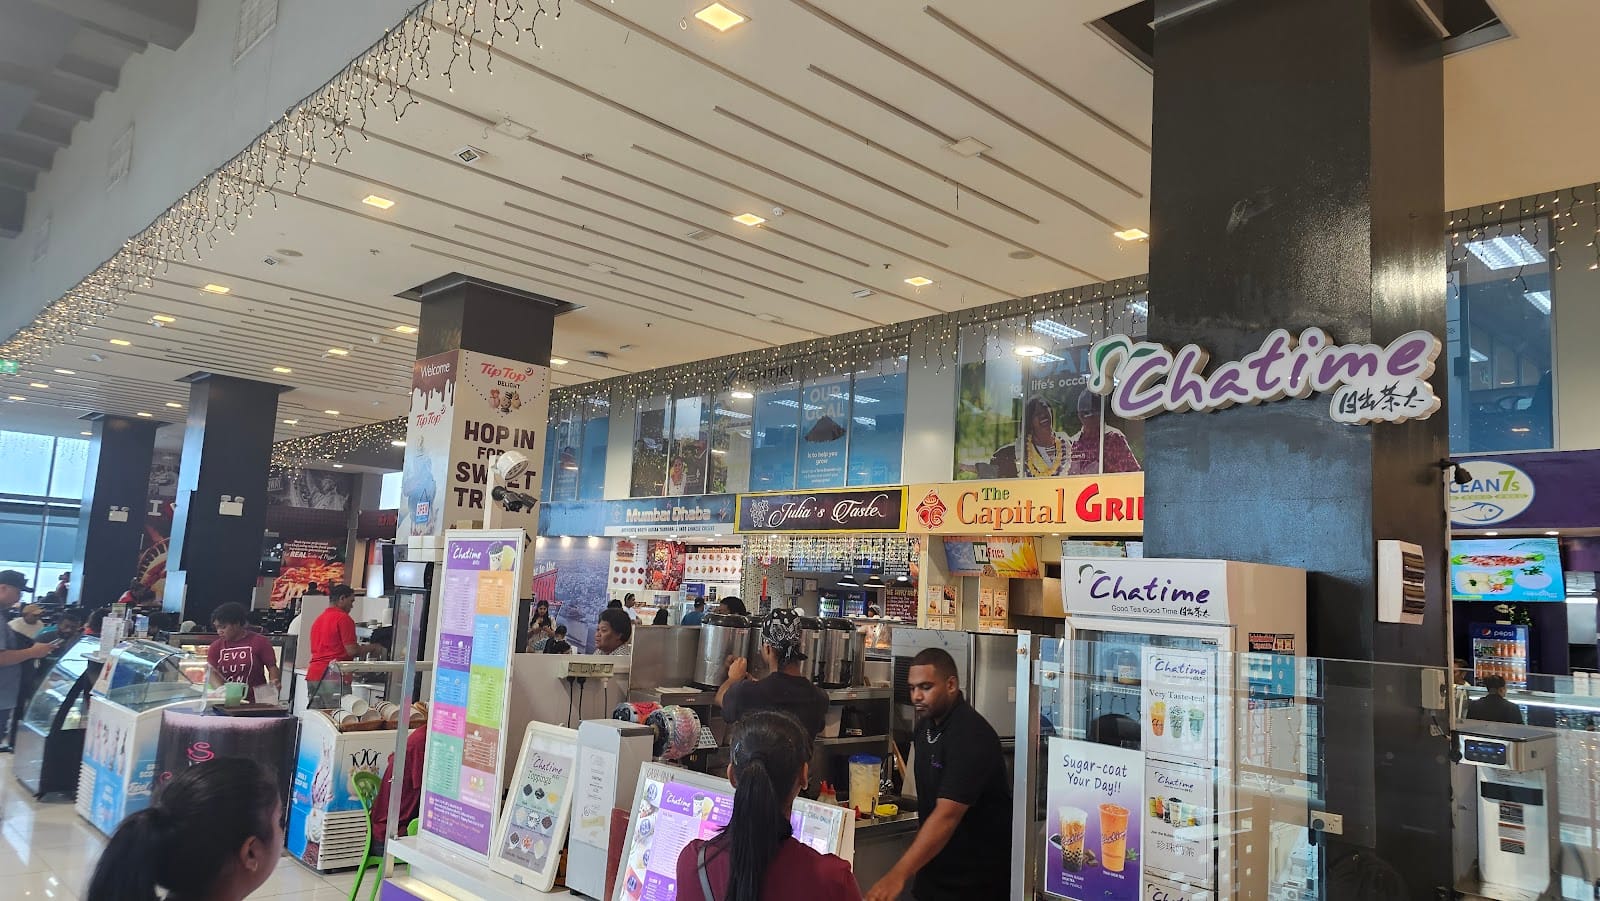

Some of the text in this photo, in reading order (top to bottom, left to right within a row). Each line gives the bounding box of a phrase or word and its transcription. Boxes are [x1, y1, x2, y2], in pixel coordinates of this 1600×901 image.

[420, 363, 450, 379] Welcome
[1118, 333, 1427, 412] Chatime
[1031, 378, 1055, 391] life's
[1058, 377, 1088, 388] occa
[810, 385, 841, 403] OUR
[463, 419, 510, 445] HOP
[513, 427, 536, 450] IN
[455, 461, 537, 490] SWT
[1449, 470, 1520, 493] CEAN7s
[981, 487, 1010, 501] The
[625, 504, 711, 523] Mumbai Dhaba
[768, 493, 889, 528] Julia's Taste
[956, 487, 1067, 531] Capital
[453, 547, 482, 560] Chatime
[987, 547, 1005, 559] Fries
[1090, 575, 1211, 604] Chatime
[1111, 604, 1178, 615] Good Tea Good Time
[223, 651, 247, 661] EVO
[221, 663, 247, 673] LUT
[1154, 660, 1207, 676] Chatime
[1149, 688, 1166, 700] Very
[533, 758, 563, 775] Chatime
[1063, 754, 1128, 778] Sugar-coat
[1066, 771, 1121, 797] Your Day!!
[1157, 775, 1194, 789] Chatime
[666, 794, 692, 808] Chatime
